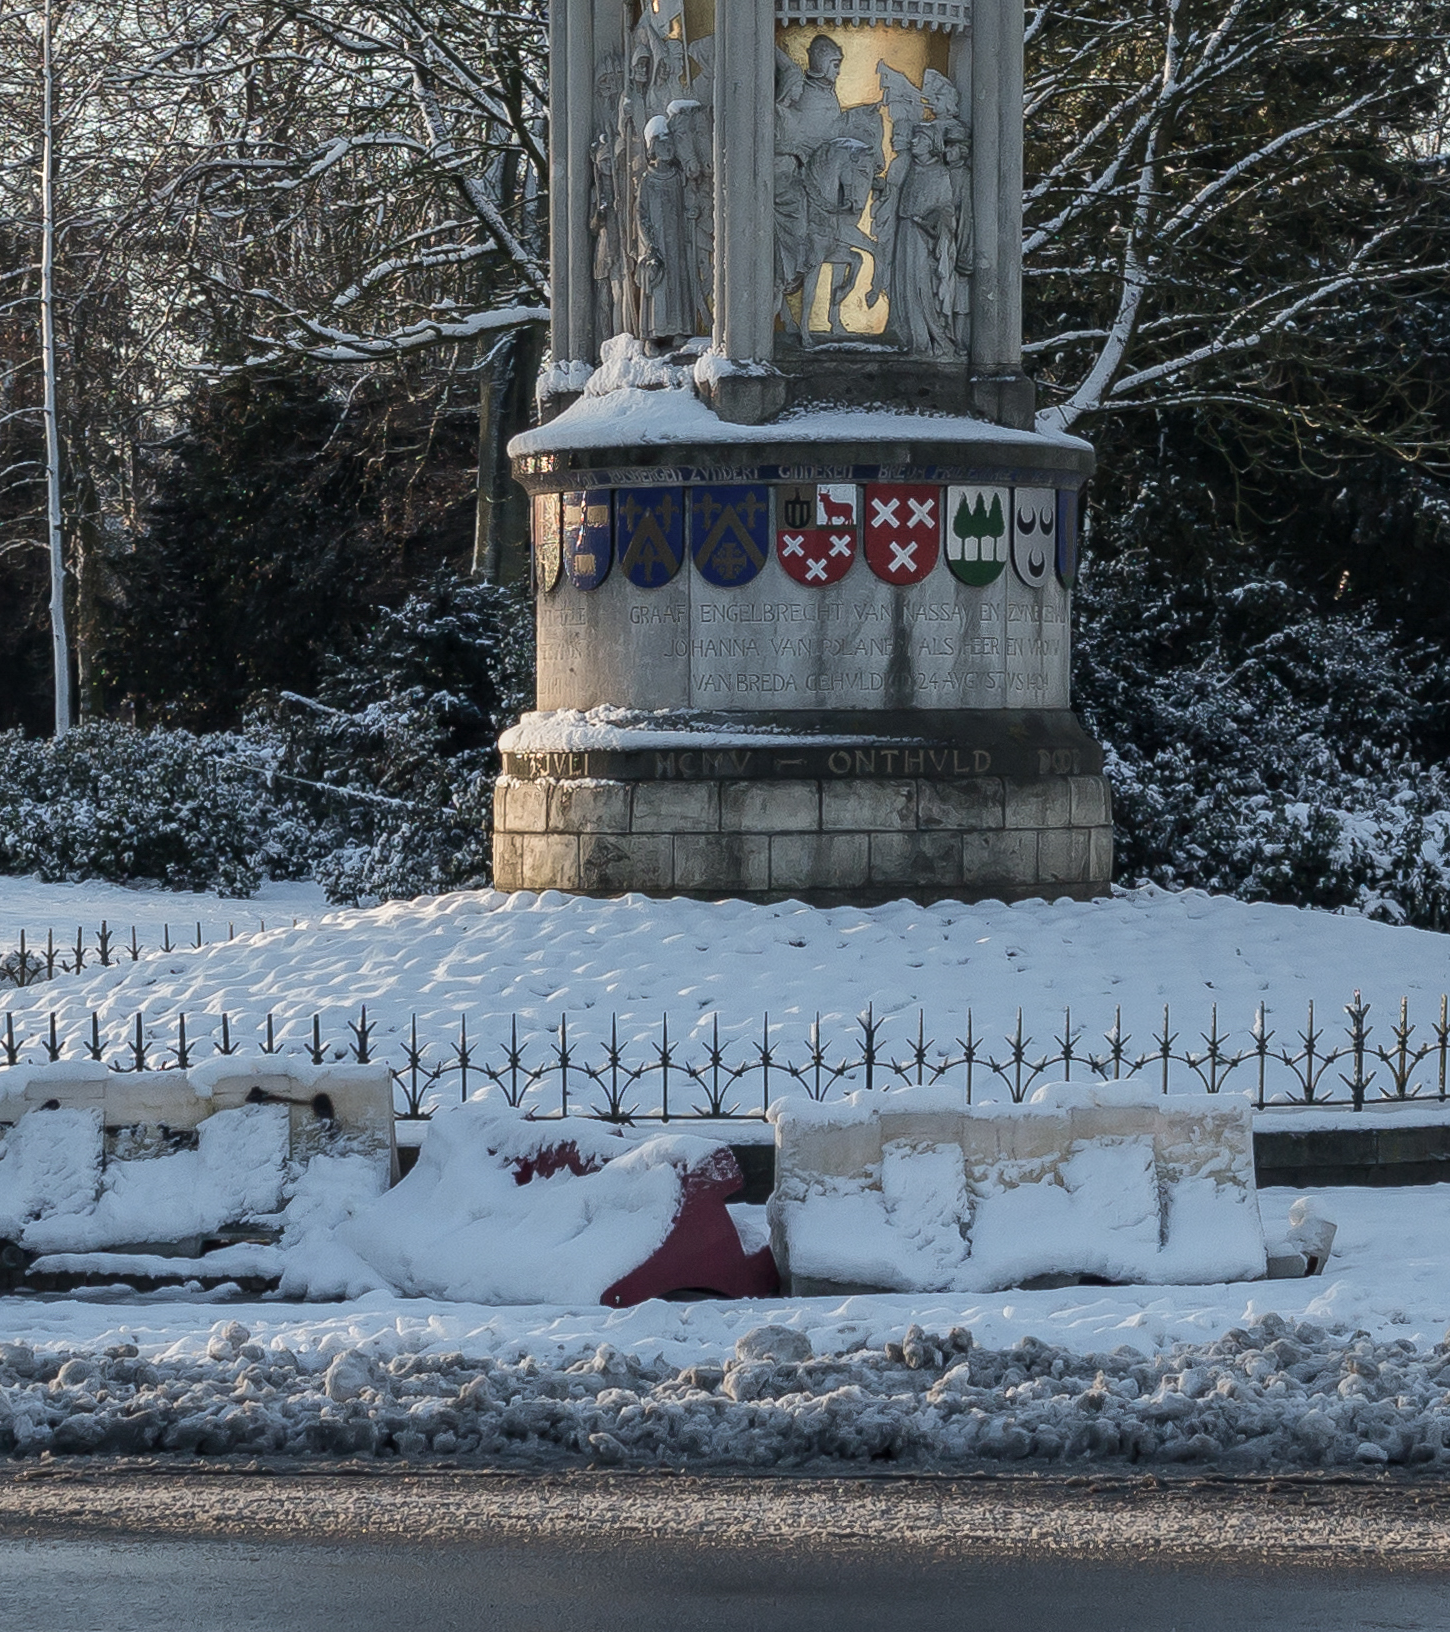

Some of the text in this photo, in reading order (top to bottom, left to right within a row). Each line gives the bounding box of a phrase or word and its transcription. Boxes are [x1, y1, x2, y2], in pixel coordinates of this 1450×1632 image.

[629, 604, 687, 624] GRAAF
[699, 603, 844, 623] ENGELBRECHT
[853, 603, 893, 622] VAN
[979, 603, 1000, 622] EN
[663, 638, 760, 657] JOHANNA
[769, 637, 812, 657] VAN
[821, 637, 904, 657] POLANE
[918, 637, 955, 656] ALS
[692, 672, 732, 692] VAN
[736, 672, 797, 692] BREDA
[805, 672, 884, 692] GEHVLD
[917, 672, 939, 690] 24
[942, 671, 1024, 691] AVGSTVS
[655, 751, 752, 778] MCMV
[827, 749, 992, 774] ONTHVLD
